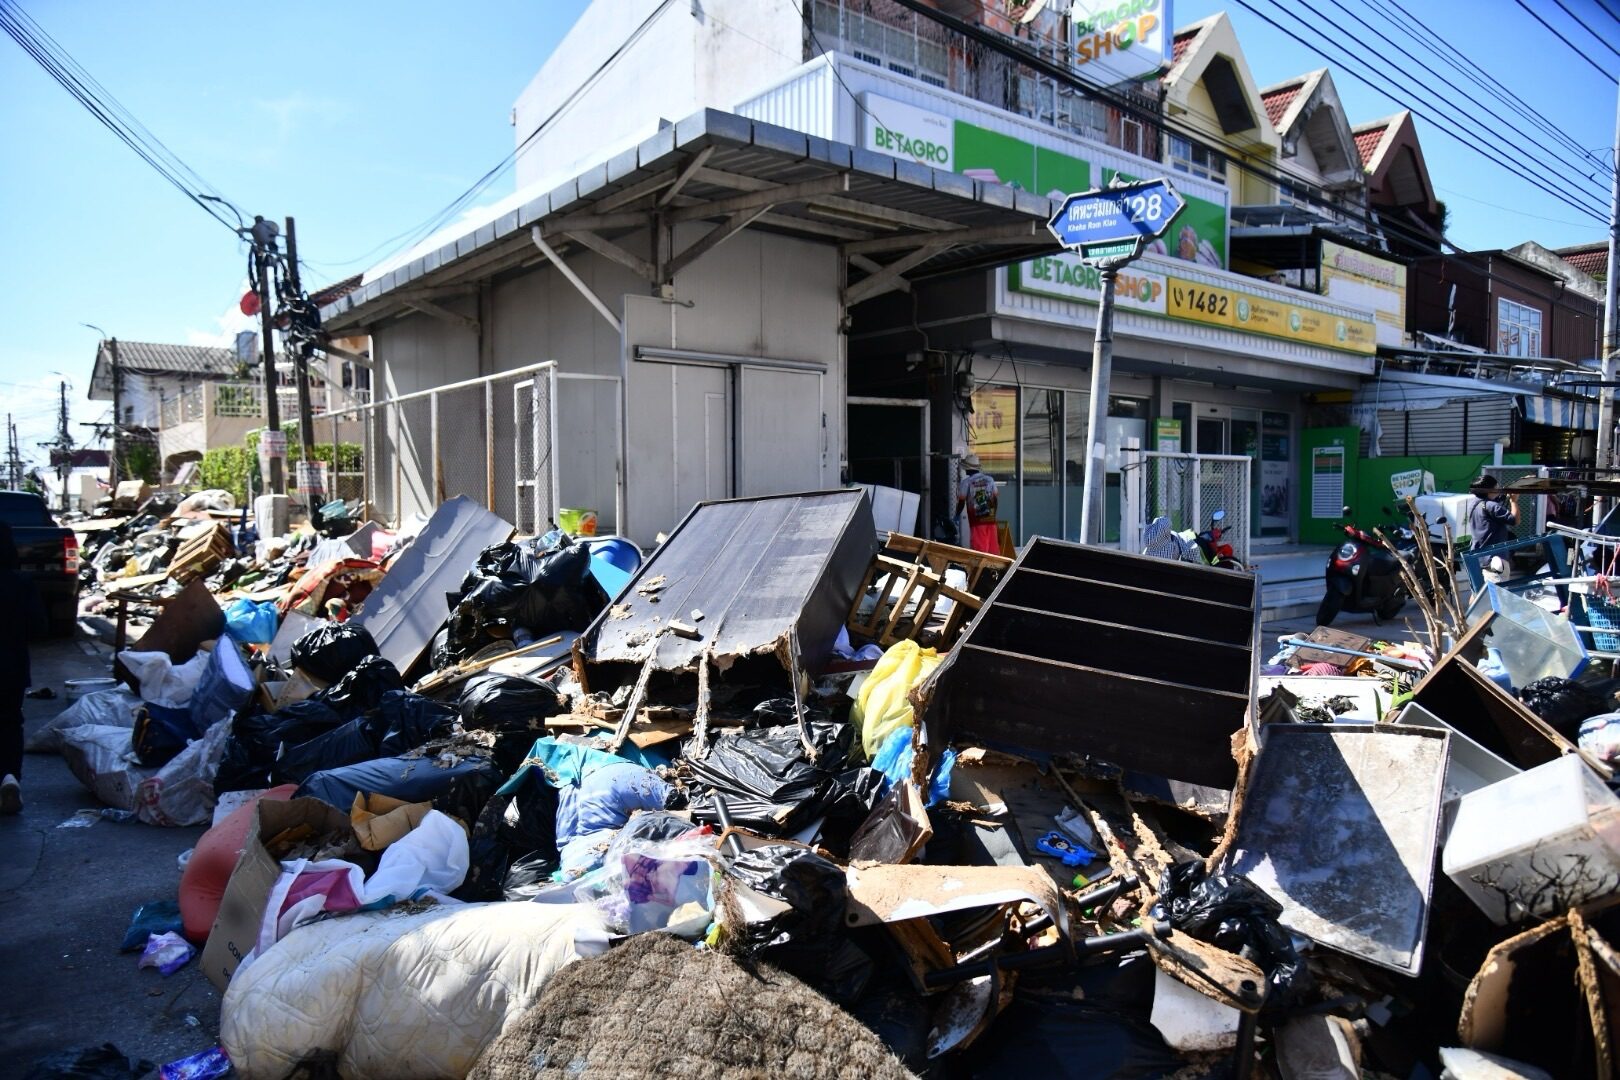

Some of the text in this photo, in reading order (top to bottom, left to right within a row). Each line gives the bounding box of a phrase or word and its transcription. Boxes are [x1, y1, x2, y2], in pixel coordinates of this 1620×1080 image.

[1077, 14, 1156, 65] SHOP
[875, 127, 949, 164] BETAGRO
[1068, 192, 1162, 223] เคหะร่มเกล้า 28
[1114, 273, 1162, 302] SHOP
[1188, 289, 1228, 316] 1482
